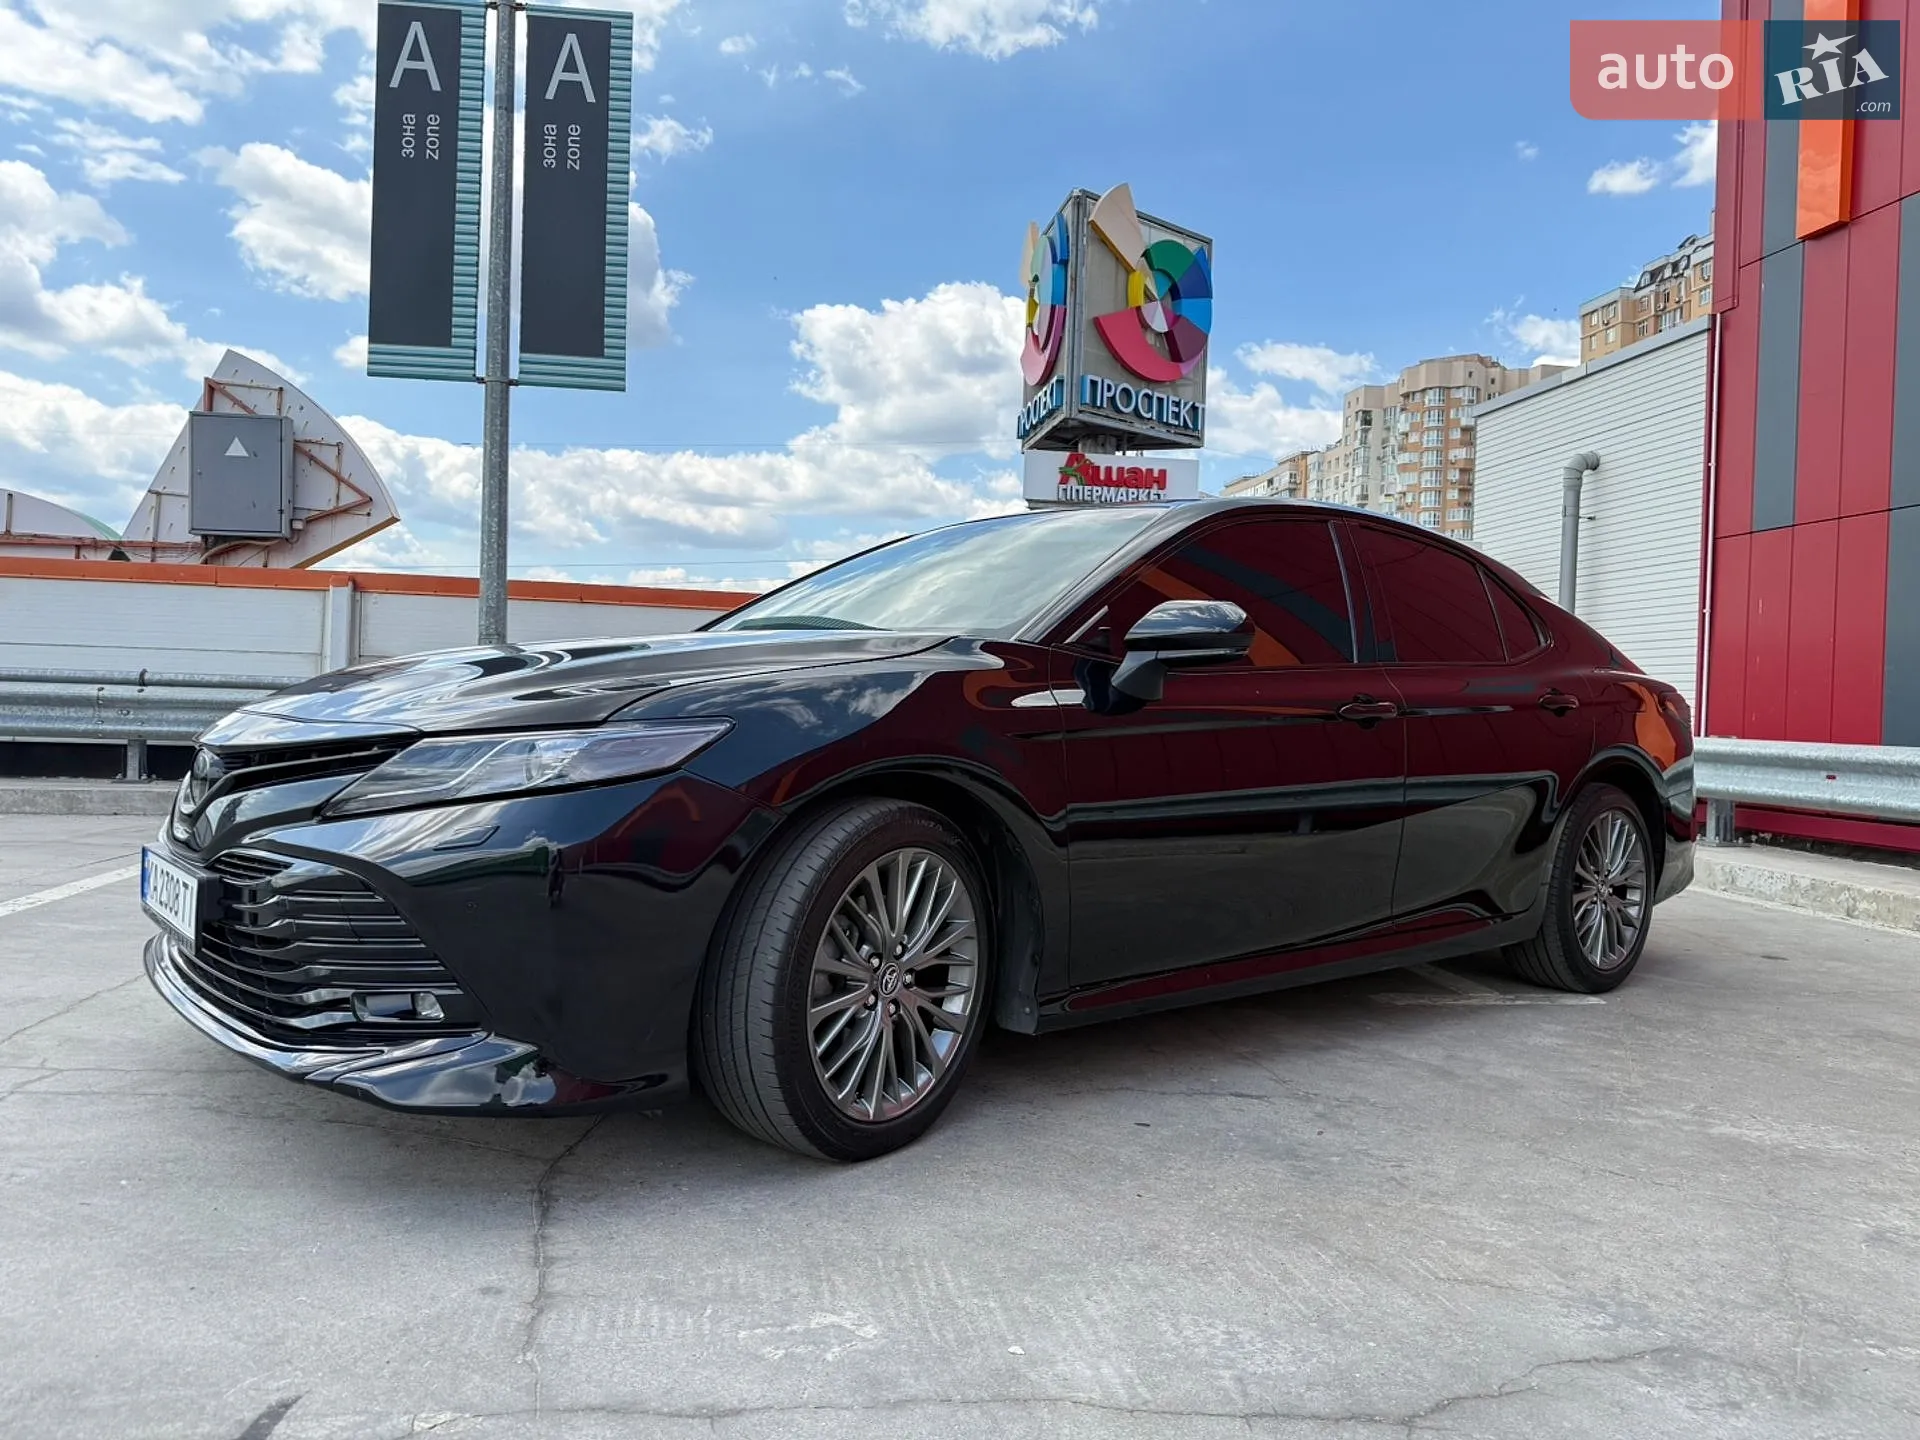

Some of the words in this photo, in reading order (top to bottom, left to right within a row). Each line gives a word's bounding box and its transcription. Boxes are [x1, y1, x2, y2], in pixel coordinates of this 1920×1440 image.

[425, 113, 440, 161] zone
[566, 123, 581, 171] zone
[1081, 374, 1207, 431] ПРОСПЕКТ
[1058, 452, 1168, 491] Ашан
